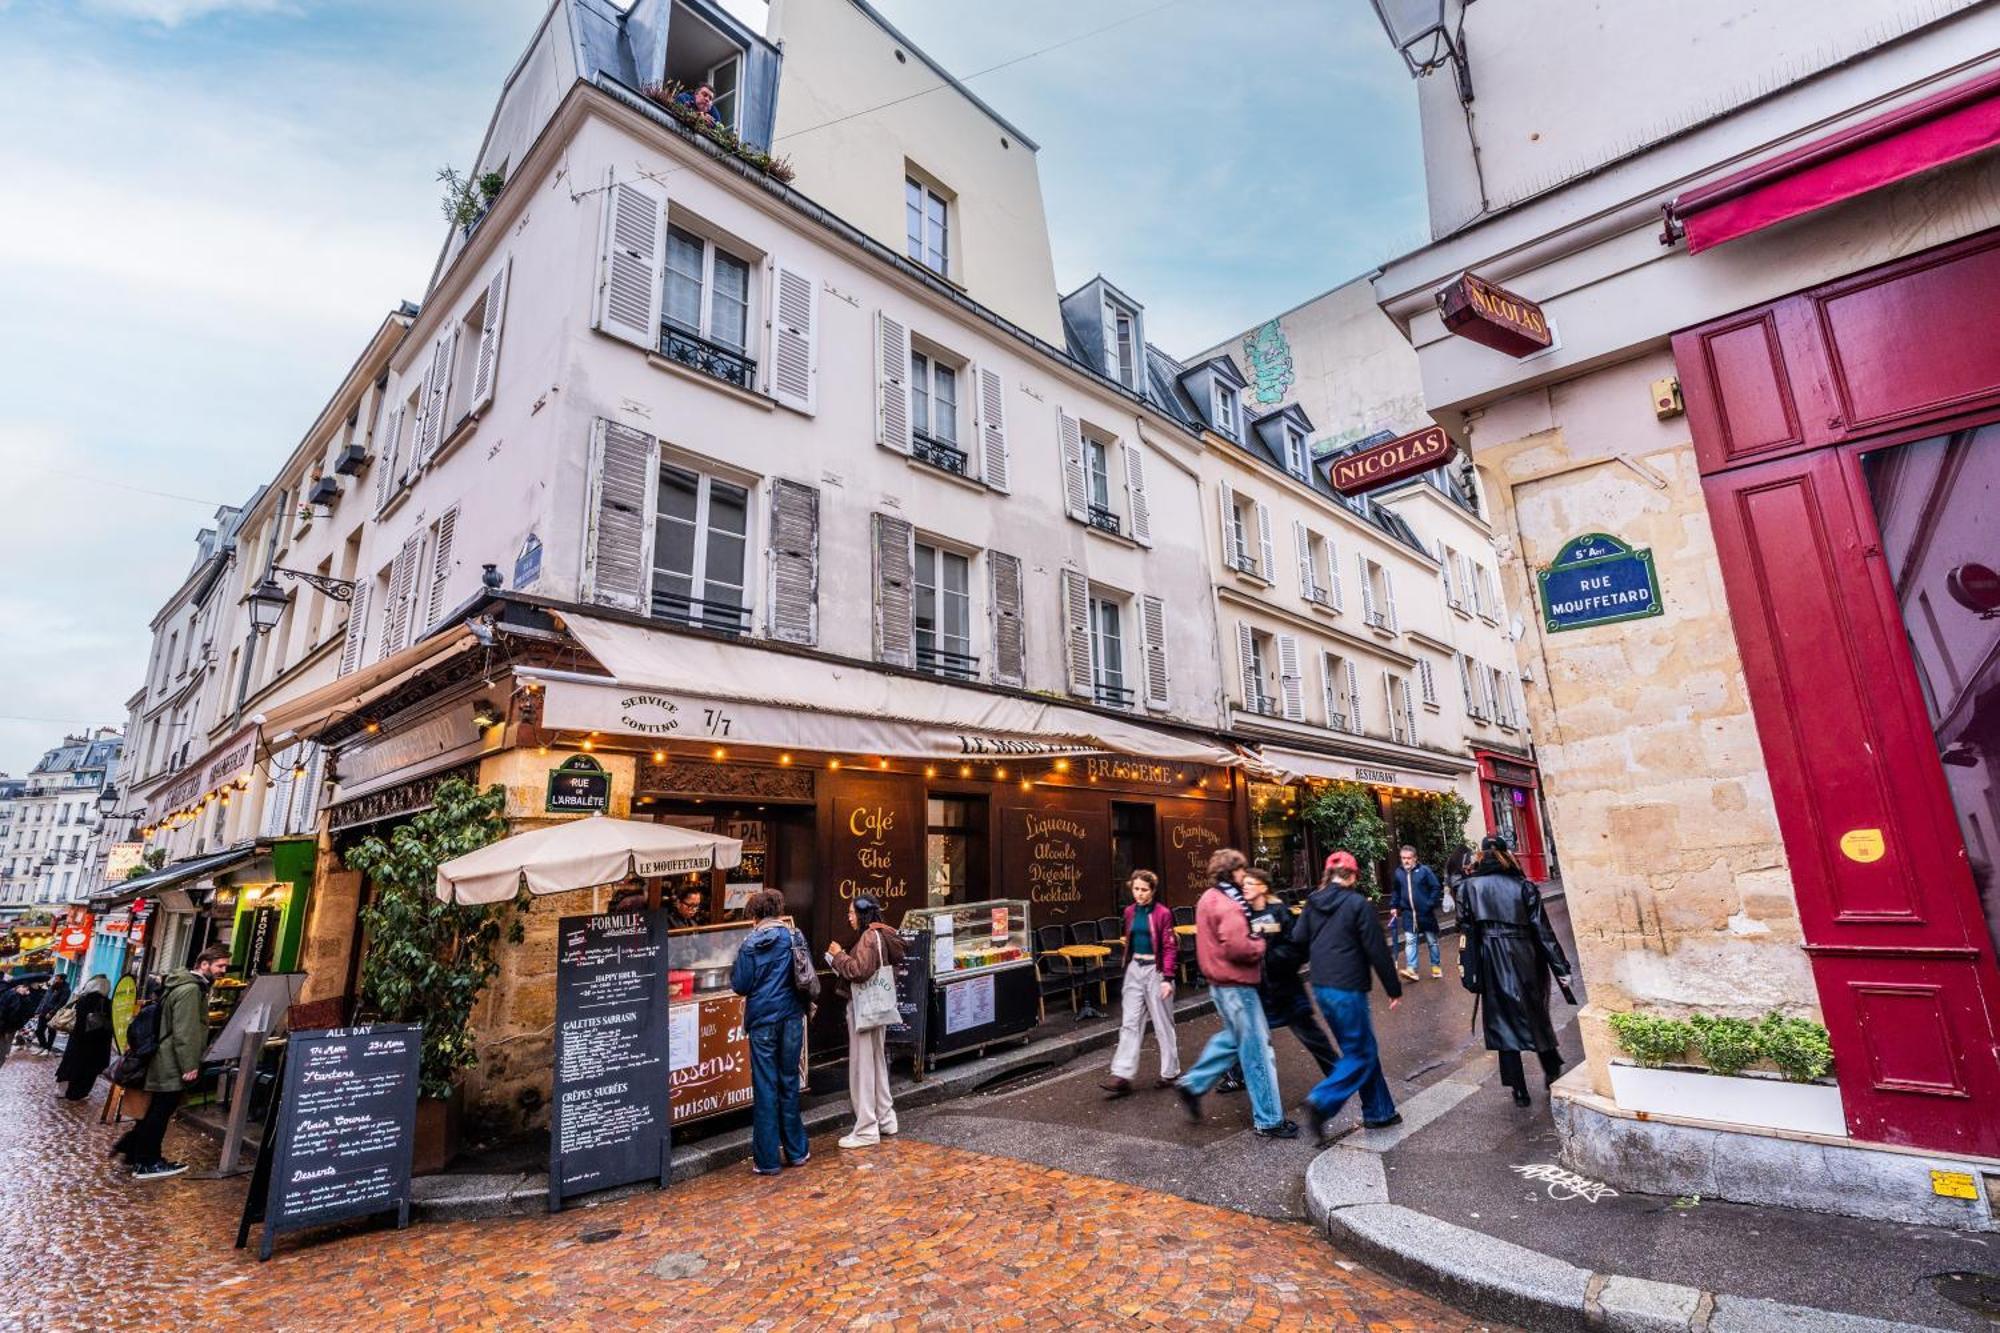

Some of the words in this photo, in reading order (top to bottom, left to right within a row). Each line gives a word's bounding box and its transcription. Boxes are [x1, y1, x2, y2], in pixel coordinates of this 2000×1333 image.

[1471, 287, 1542, 333] NICOLAS
[1340, 434, 1440, 482] NICOLAS
[1580, 576, 1612, 591] RUE
[1552, 588, 1650, 615] MOUFFETARD
[621, 695, 678, 714] SERVICE
[621, 715, 679, 733] CONTINU
[704, 708, 731, 736] 7/7
[1087, 758, 1172, 784] BRASSERIE
[1355, 767, 1397, 784] RESTAURANT
[571, 778, 590, 788] RUE
[850, 807, 896, 840] Café
[1026, 814, 1087, 840] Liqueurs
[858, 848, 893, 868] Thé
[1034, 843, 1076, 859] Alcools
[640, 862, 651, 874] LE
[653, 857, 711, 872] MOUFFETARD
[1029, 863, 1082, 887] Digestifs
[840, 877, 908, 899] Chocolat
[1031, 885, 1081, 902] Cocktails
[595, 973, 618, 983] HAPPY
[618, 970, 637, 979] HOUR
[563, 1016, 601, 1031] GALETTES
[602, 1010, 638, 1025] SARRASIN
[326, 1028, 347, 1038] ALL
[352, 1026, 372, 1036] DAY
[303, 1068, 355, 1082] Starters
[562, 1089, 593, 1103] CRÊPES
[594, 1082, 628, 1098] SUCRÉES
[296, 1119, 330, 1132] Main
[334, 1114, 372, 1126] Course
[291, 1165, 337, 1182] Desserts
